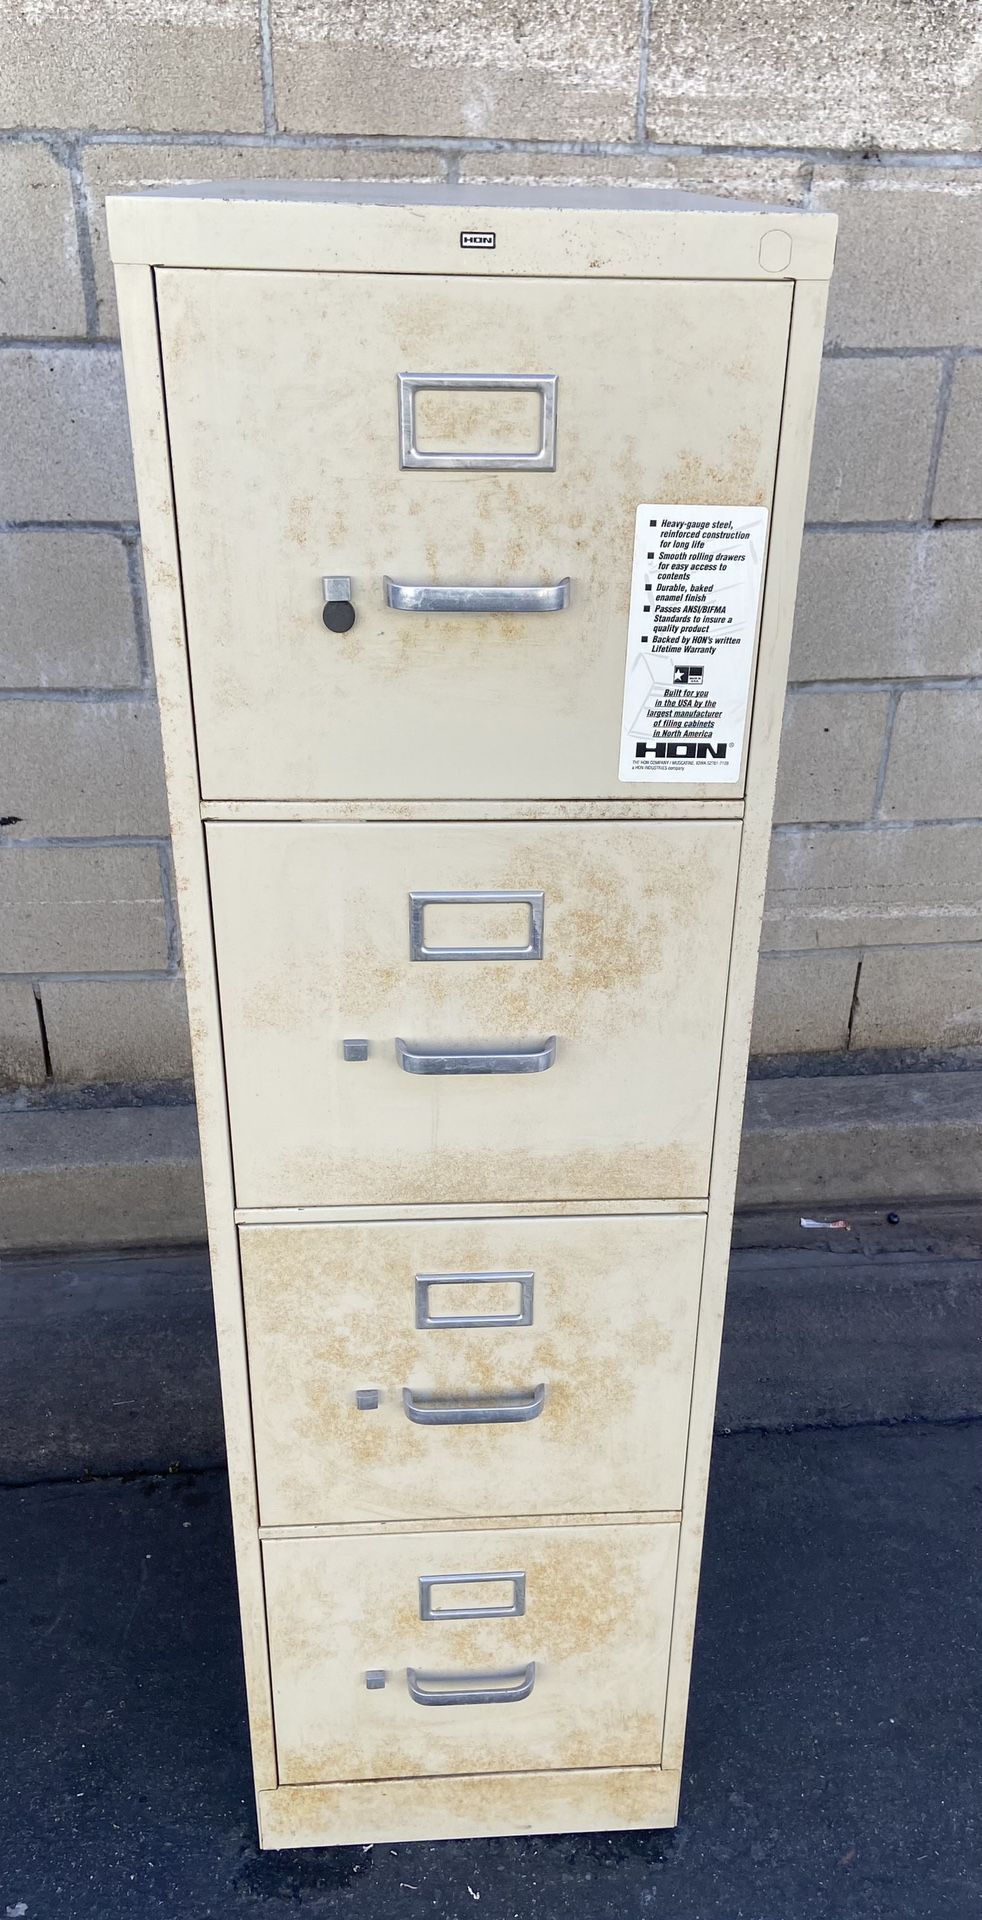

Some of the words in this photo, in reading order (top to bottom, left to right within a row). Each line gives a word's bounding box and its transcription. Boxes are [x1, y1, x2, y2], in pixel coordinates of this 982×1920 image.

[661, 519, 710, 530] Heavy-gauge
[712, 520, 734, 530] steel,
[660, 530, 701, 539] reinforced
[702, 530, 750, 540] construction
[660, 540, 671, 548] for
[673, 540, 690, 549] long
[691, 541, 705, 549] life
[658, 552, 687, 561] Smooth
[688, 552, 713, 562] rolling
[715, 553, 746, 561] drawers
[658, 562, 669, 570] for
[671, 563, 689, 571] easy
[690, 563, 717, 571] access
[719, 563, 727, 571] to
[657, 572, 691, 580] contents
[656, 584, 687, 593] Durable,
[690, 584, 714, 592] baked
[655, 594, 684, 602] enamel
[685, 594, 707, 602] finish
[654, 605, 681, 613] Passes
[682, 605, 726, 614] ANSI/BIFMA
[654, 615, 691, 623] Standards
[693, 615, 701, 623] to
[702, 615, 725, 623] insure
[653, 624, 679, 634] quality
[680, 625, 710, 634] product
[682, 636, 691, 645] by
[692, 636, 713, 644] HON's
[714, 637, 741, 645] written
[652, 645, 682, 653] Lifetime
[683, 645, 716, 655] Warranty
[664, 689, 681, 697] Built
[683, 689, 694, 697] for
[695, 690, 709, 698] you
[655, 699, 662, 707] in
[665, 699, 676, 707] the
[678, 699, 692, 708] USA
[694, 700, 704, 709] by
[704, 700, 717, 708] the
[647, 709, 673, 718] largest
[674, 710, 723, 718] manufacturer
[653, 720, 662, 728] of
[663, 720, 681, 728] filing
[684, 720, 715, 728] cabinets
[653, 730, 661, 738] in
[662, 730, 681, 738] North
[683, 730, 713, 738] America
